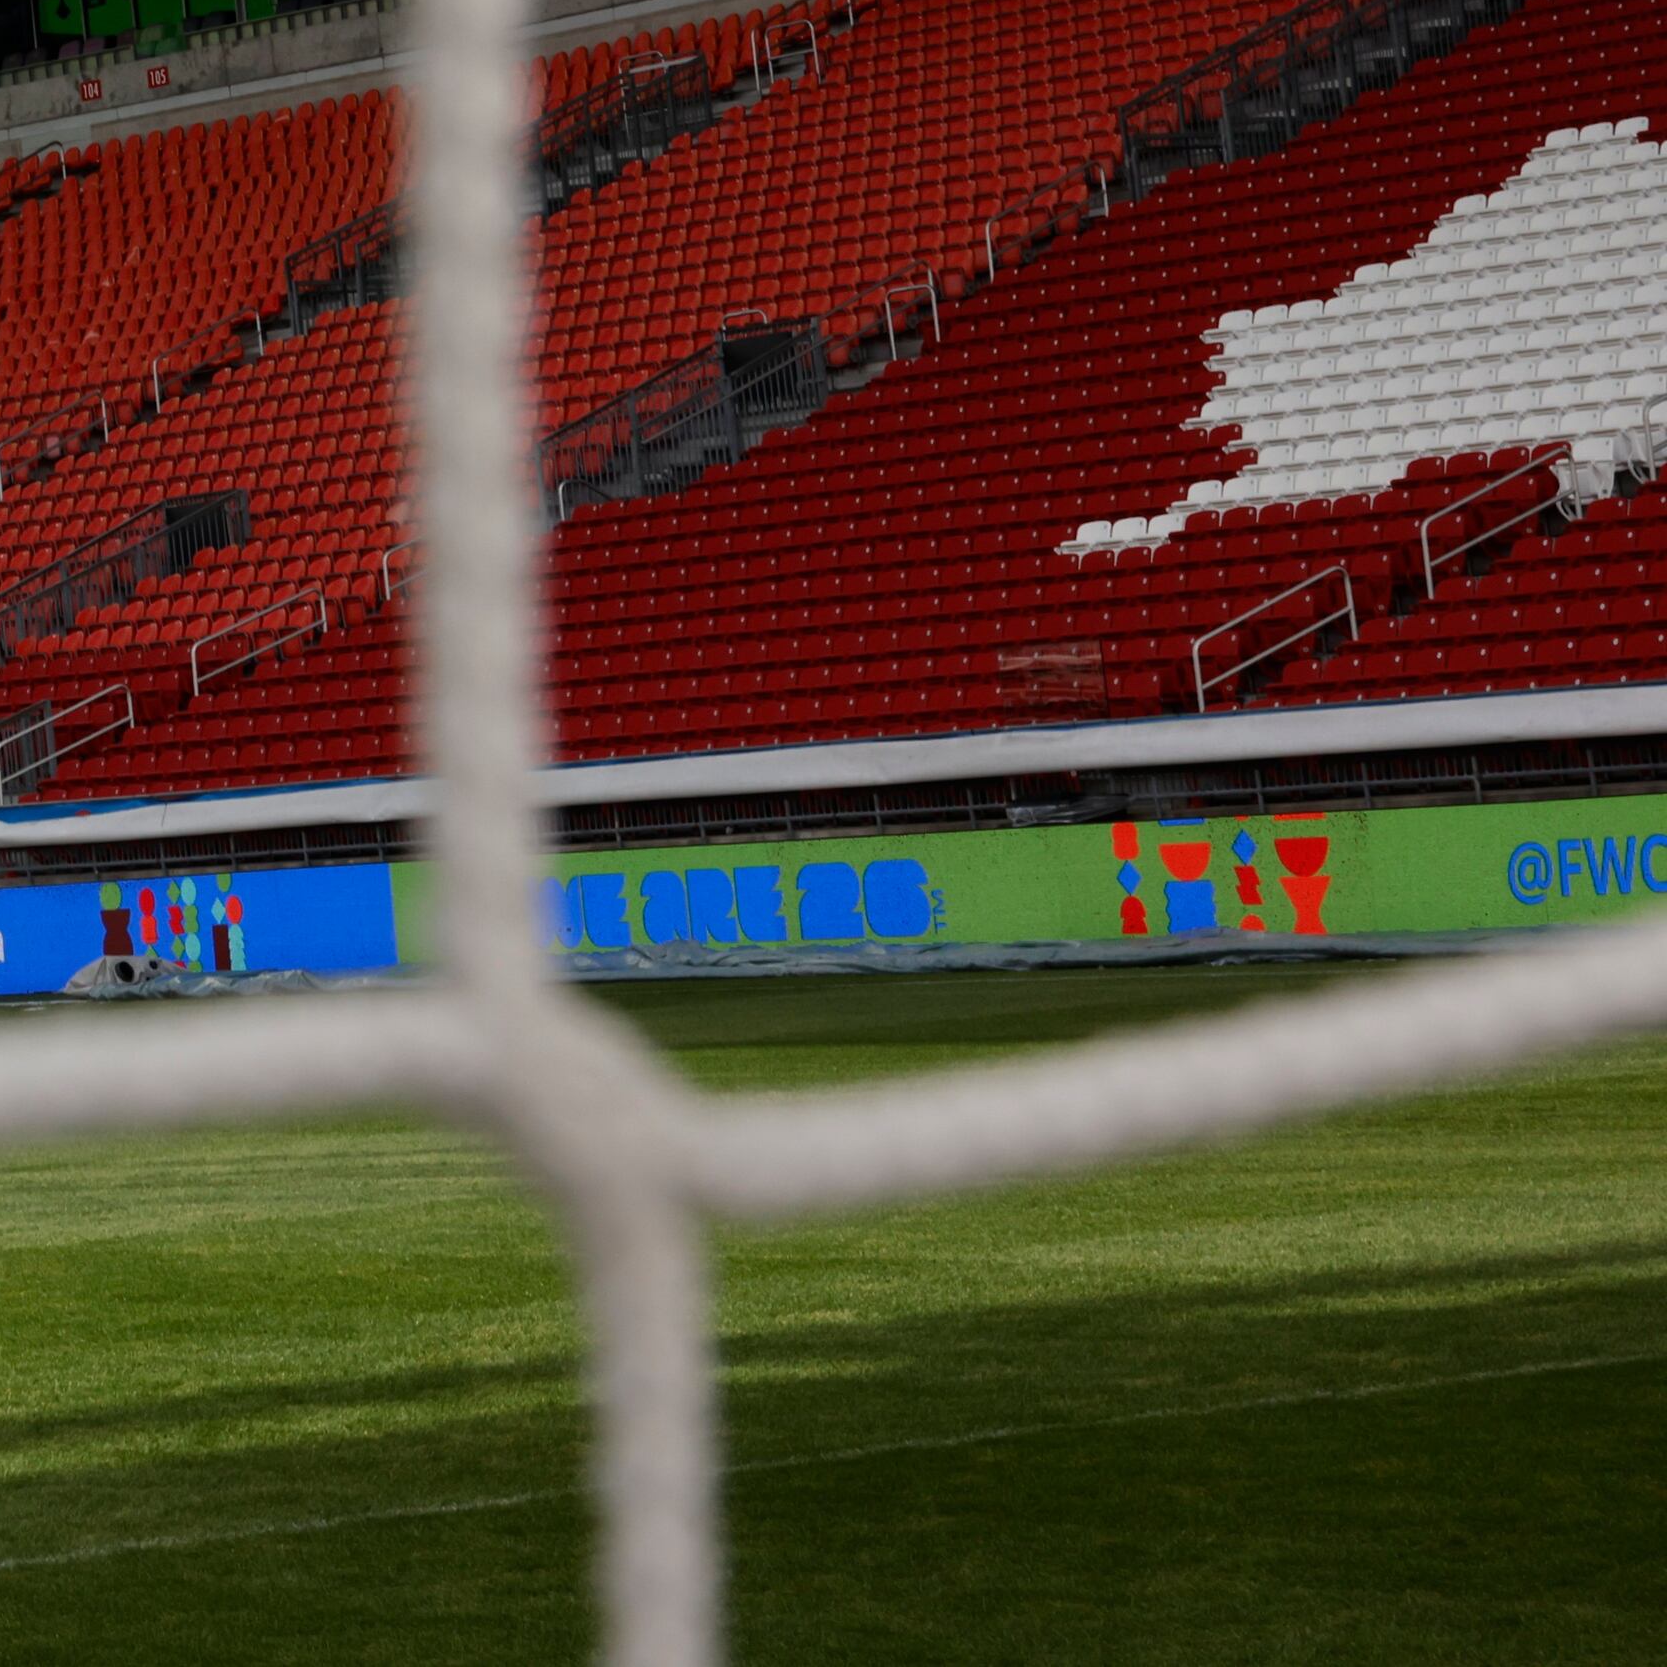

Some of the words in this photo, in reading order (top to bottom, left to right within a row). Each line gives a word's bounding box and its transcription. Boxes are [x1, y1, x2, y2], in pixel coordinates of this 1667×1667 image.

[149, 67, 167, 86] 105
[82, 82, 100, 100] 104
[640, 865, 788, 944] ARE
[796, 858, 932, 939] 26
